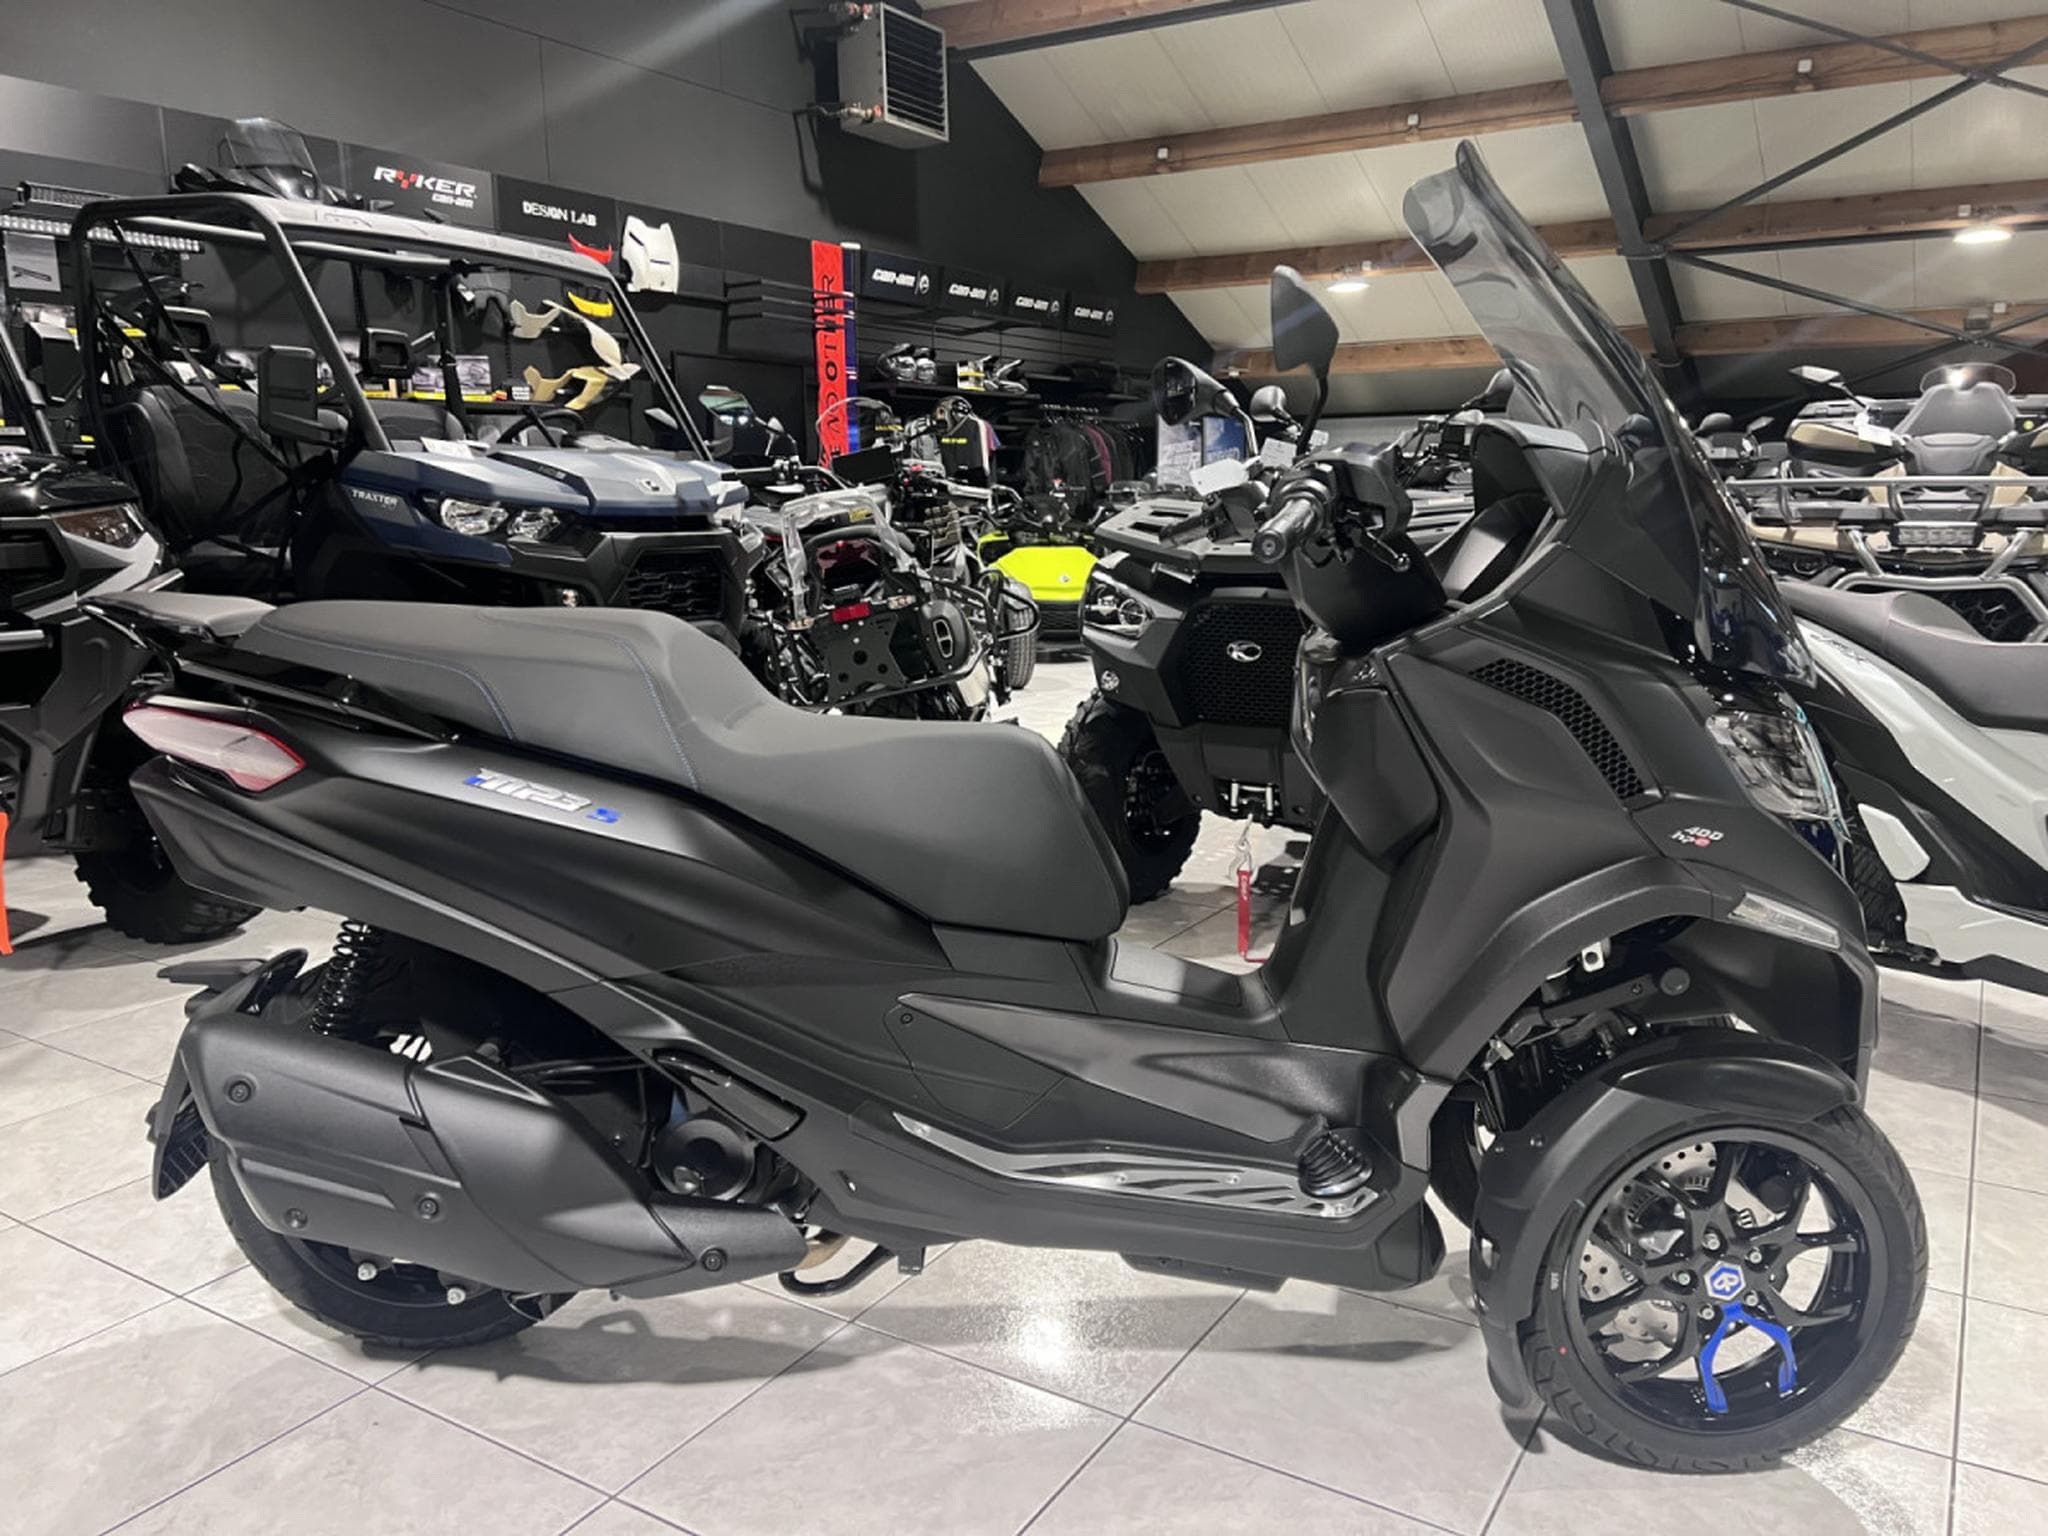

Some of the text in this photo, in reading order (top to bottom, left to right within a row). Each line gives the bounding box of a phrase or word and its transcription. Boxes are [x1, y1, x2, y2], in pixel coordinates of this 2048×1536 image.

[373, 166, 477, 198] RYKER
[522, 200, 597, 227] DESIGN LAB
[351, 489, 398, 506] TRAXTER
[1684, 827, 1724, 841] 400
